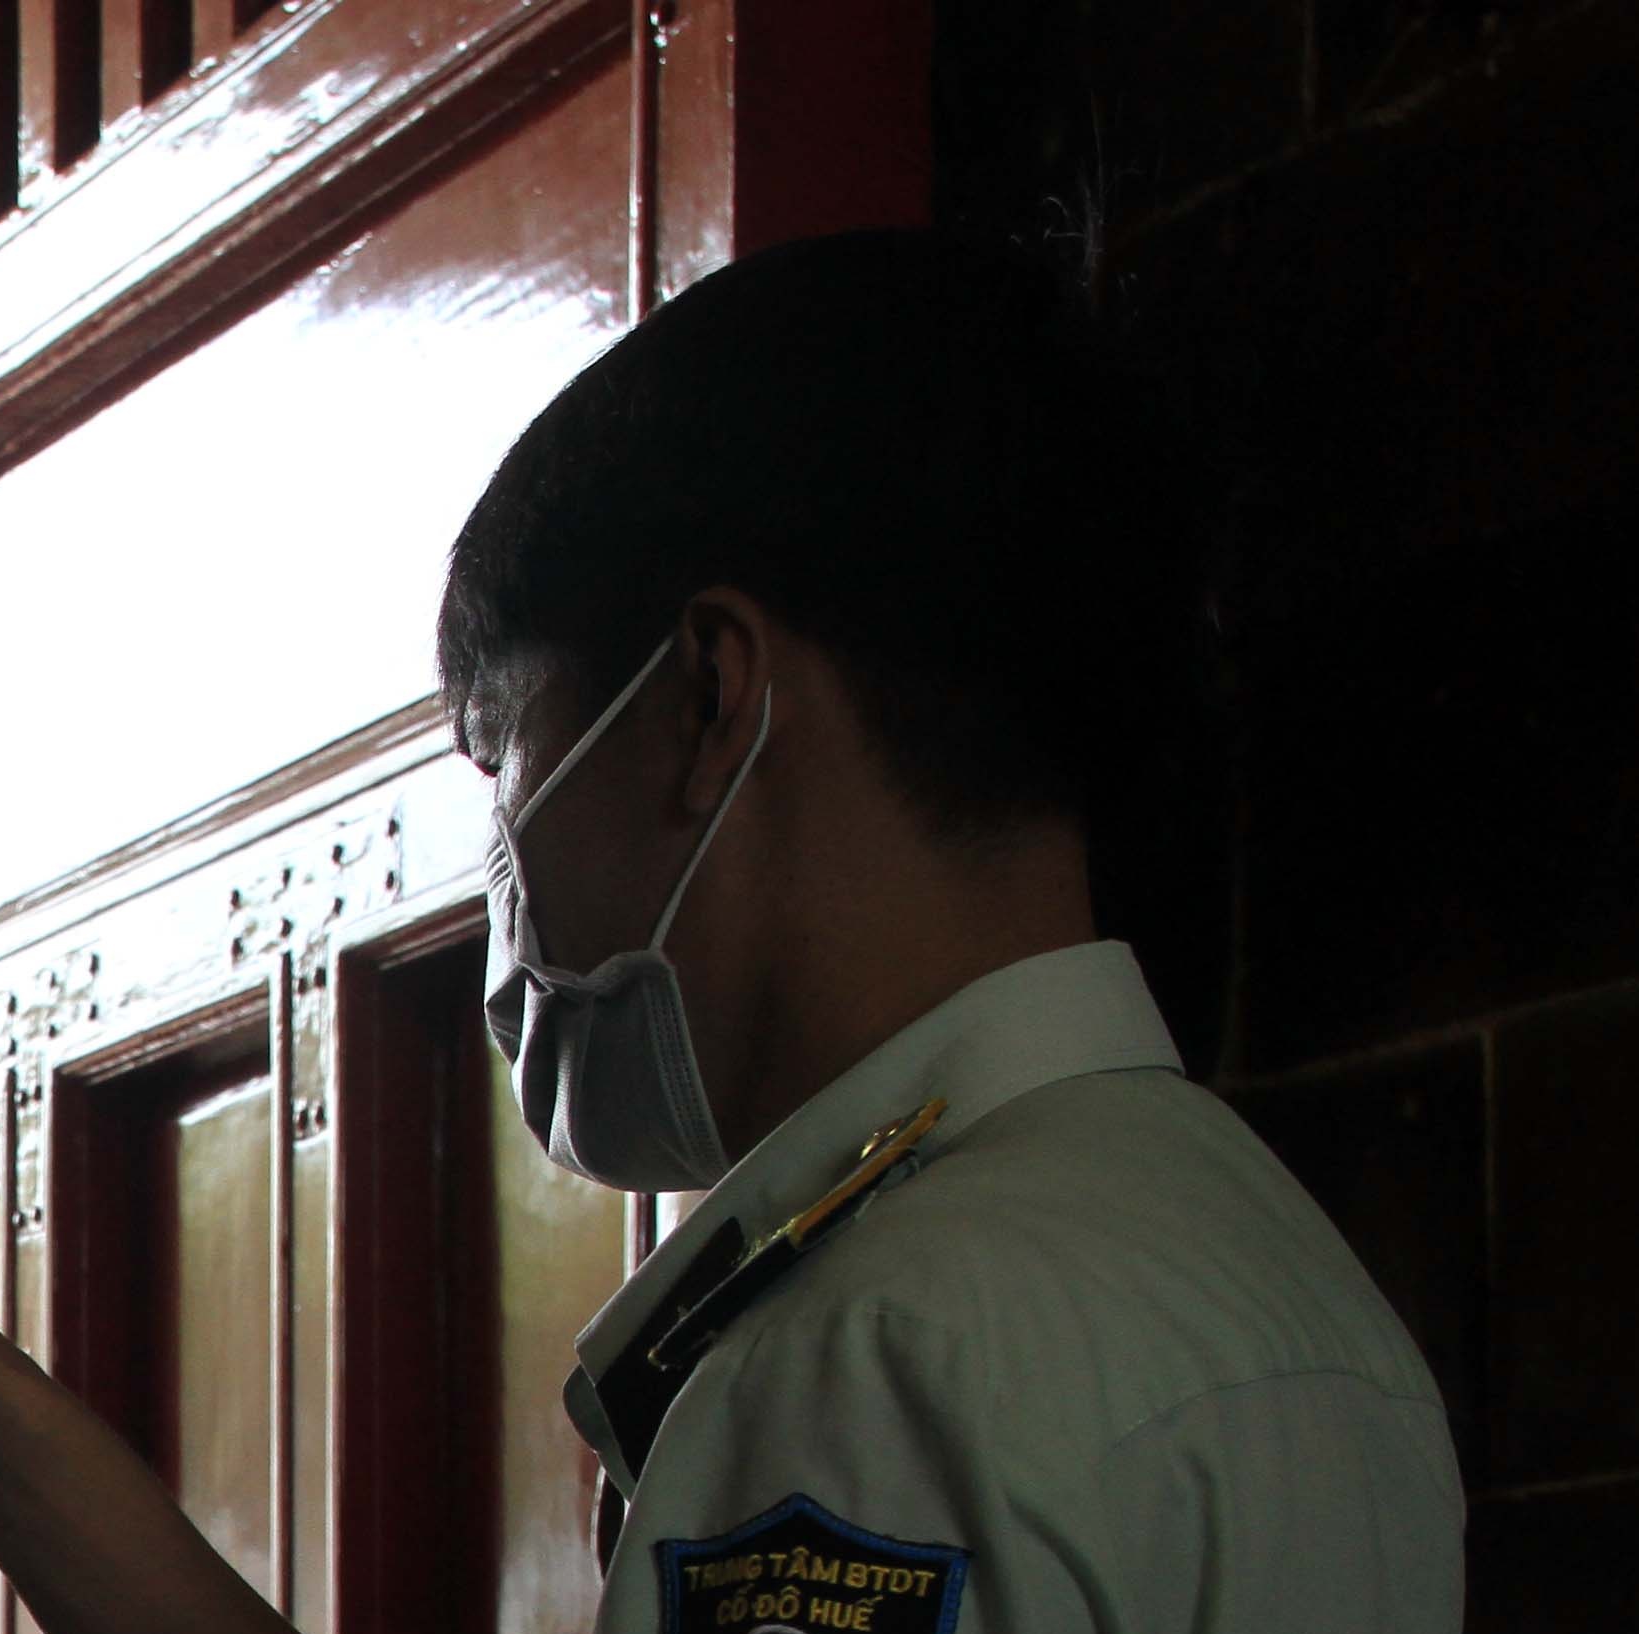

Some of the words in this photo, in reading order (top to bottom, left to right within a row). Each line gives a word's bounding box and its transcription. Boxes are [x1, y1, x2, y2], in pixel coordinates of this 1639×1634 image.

[684, 1553, 763, 1592] TRUNG
[768, 1544, 838, 1585] TÂM
[843, 1561, 936, 1598] BTDT
[715, 1583, 755, 1625] CỐ
[753, 1585, 802, 1620] ĐÔ
[808, 1595, 883, 1633] HUẾ
